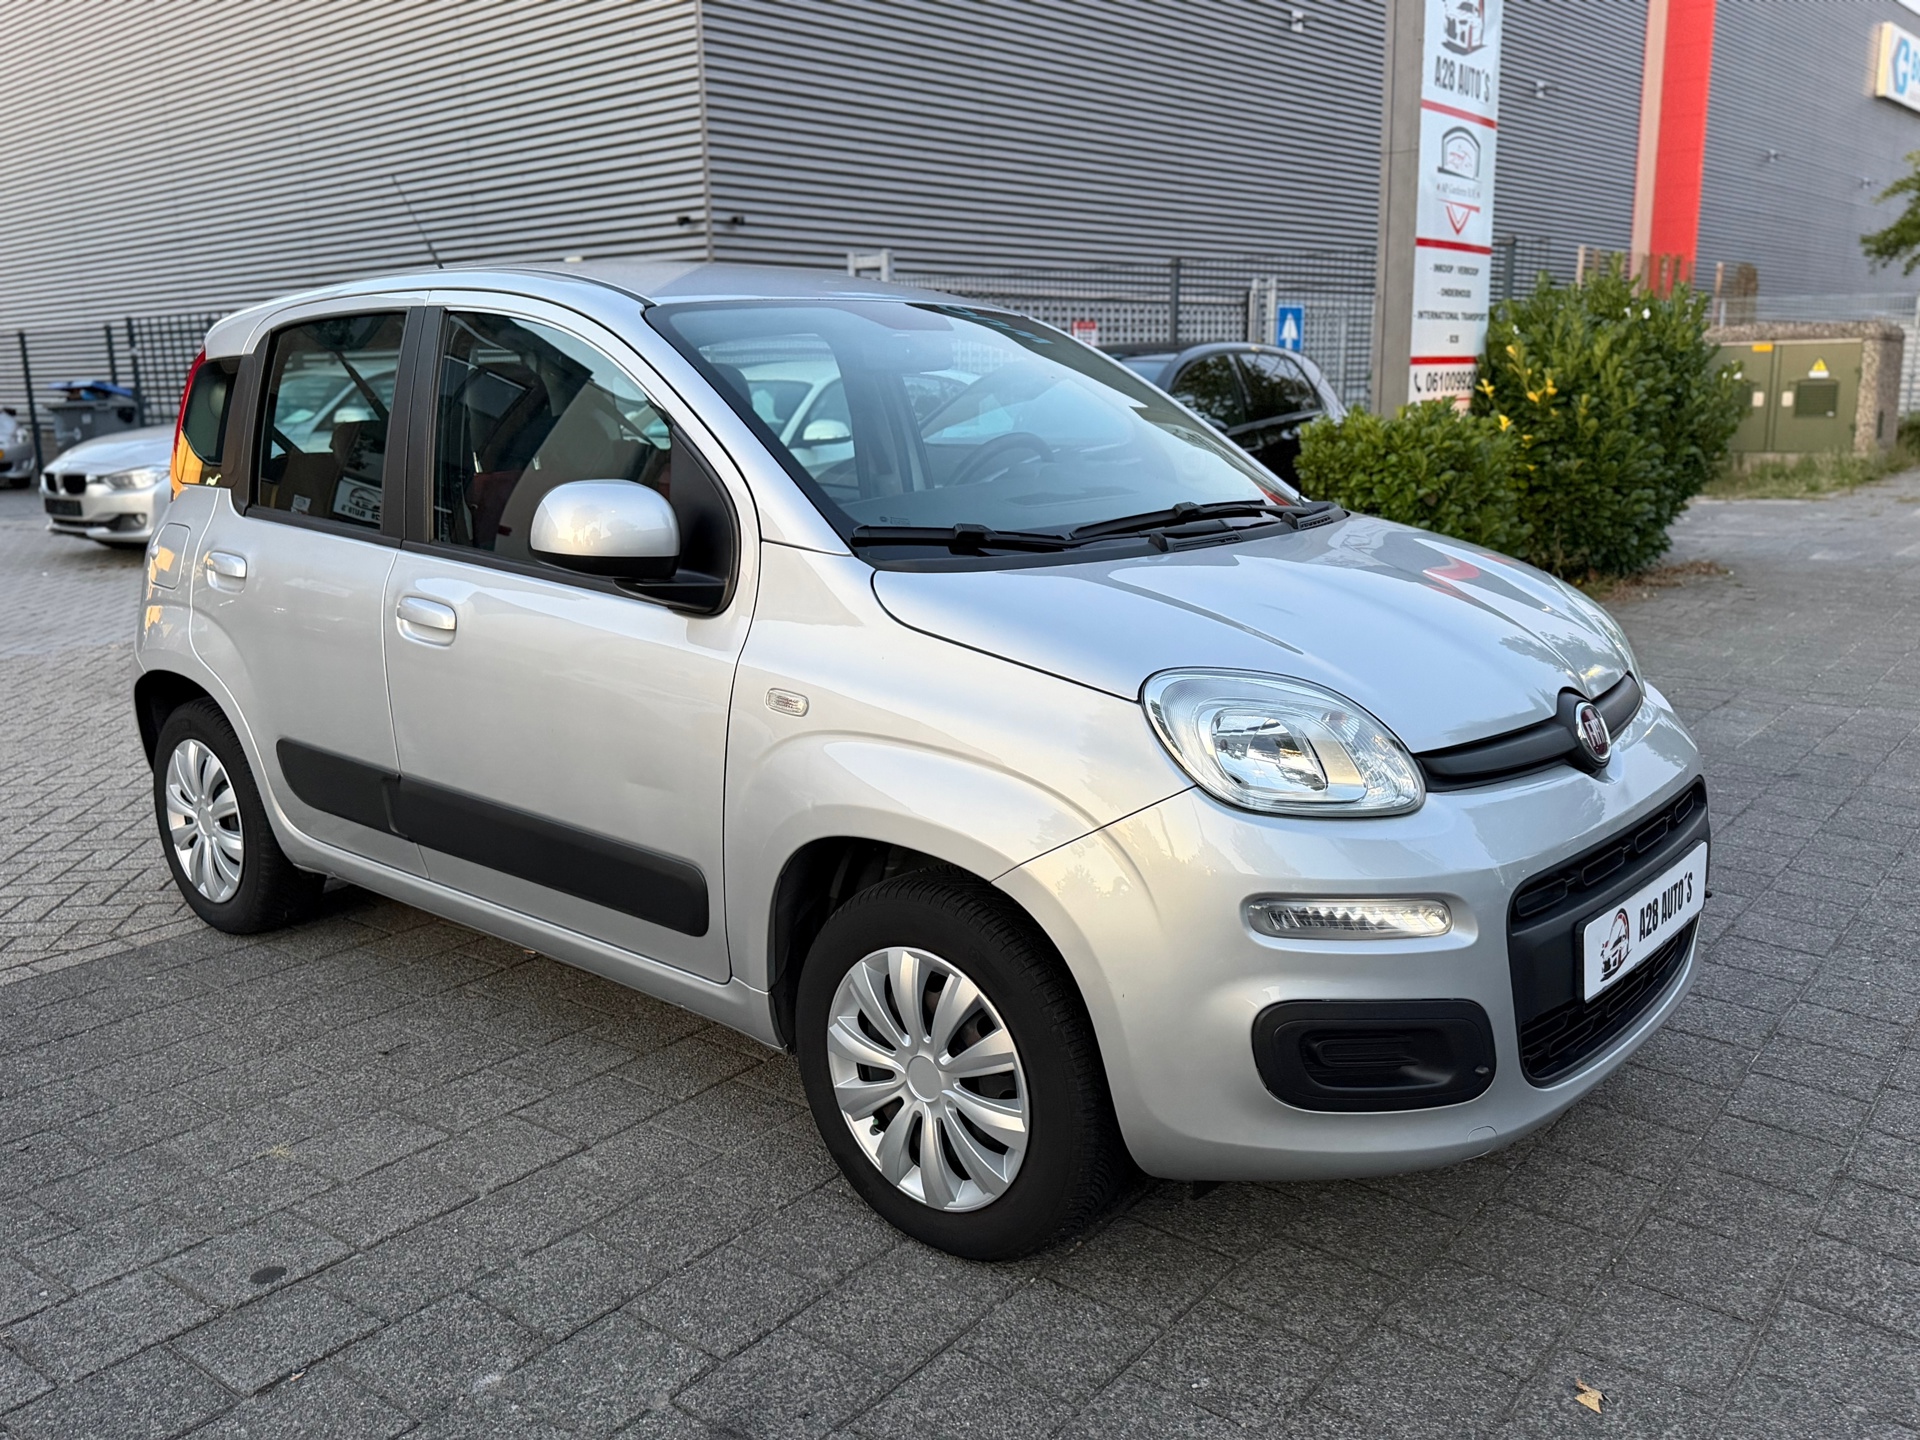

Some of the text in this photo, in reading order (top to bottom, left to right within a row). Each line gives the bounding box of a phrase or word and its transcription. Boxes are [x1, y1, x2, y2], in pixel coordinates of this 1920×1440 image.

[1434, 55, 1455, 92] A28
[1417, 310, 1487, 322] INTERNATIONAL TRANSPORT
[1639, 898, 1659, 942] A28
